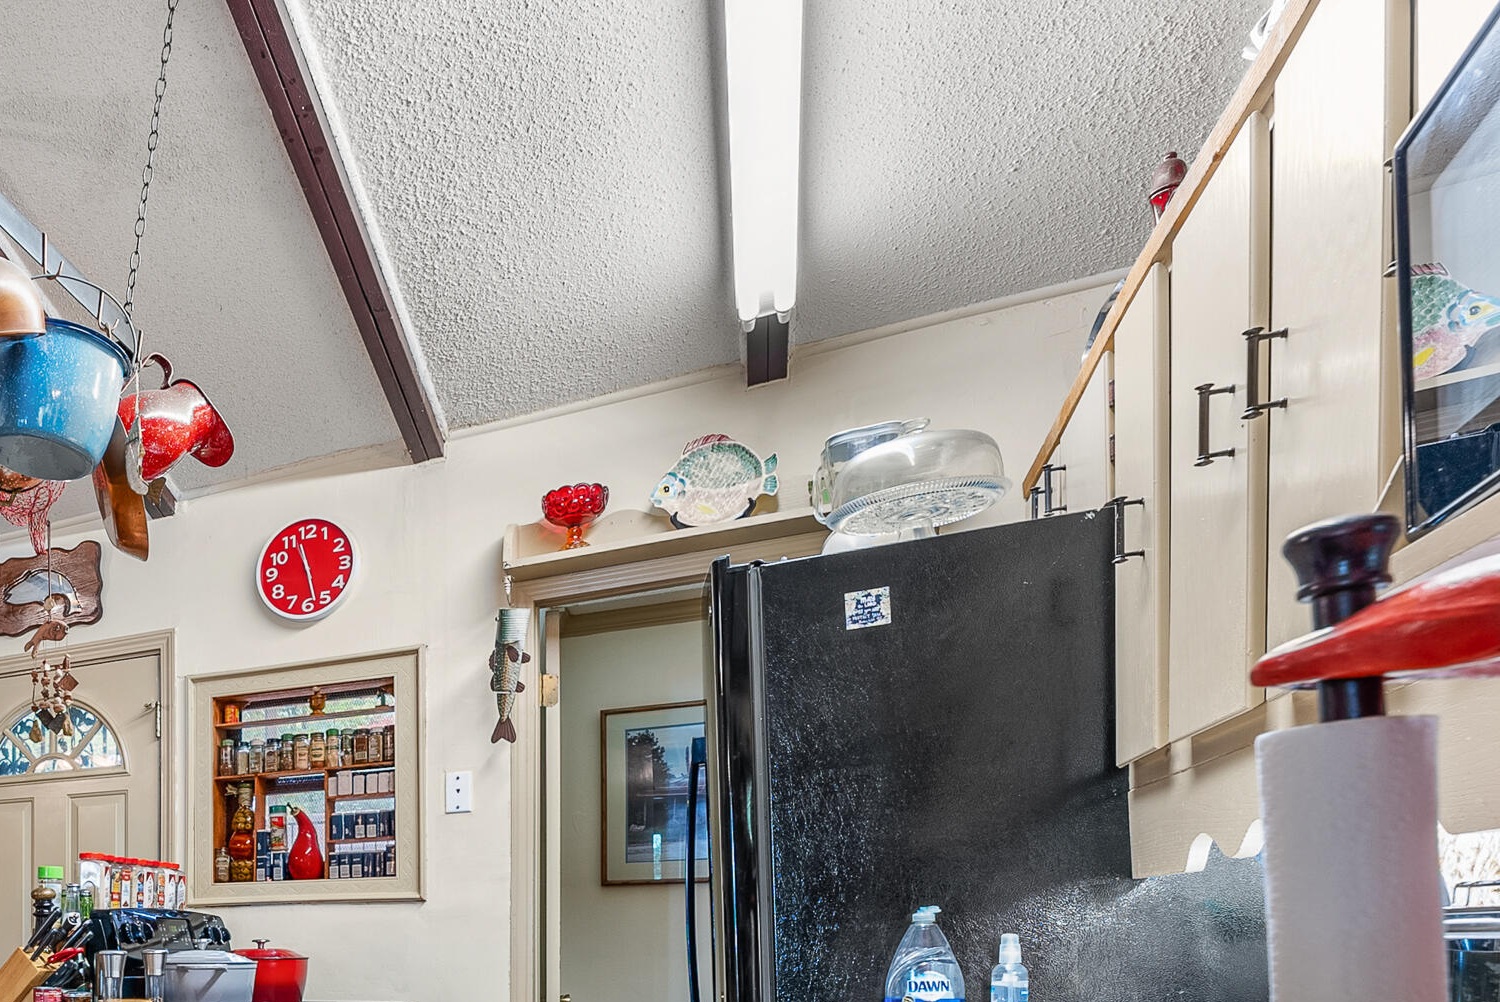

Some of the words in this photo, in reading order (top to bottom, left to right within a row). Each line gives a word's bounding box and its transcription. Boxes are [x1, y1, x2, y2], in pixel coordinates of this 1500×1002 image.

[298, 524, 317, 540] 12
[321, 526, 328, 540] 1
[282, 534, 296, 549] 11
[332, 537, 345, 552] 2
[270, 551, 288, 566] 10
[338, 555, 351, 570] 3
[265, 567, 278, 583] 9
[331, 574, 345, 589] 4
[271, 584, 285, 599] 8
[319, 590, 331, 604] 5
[286, 594, 298, 610] 7
[301, 597, 315, 612] 6
[908, 980, 950, 992] DAWN
